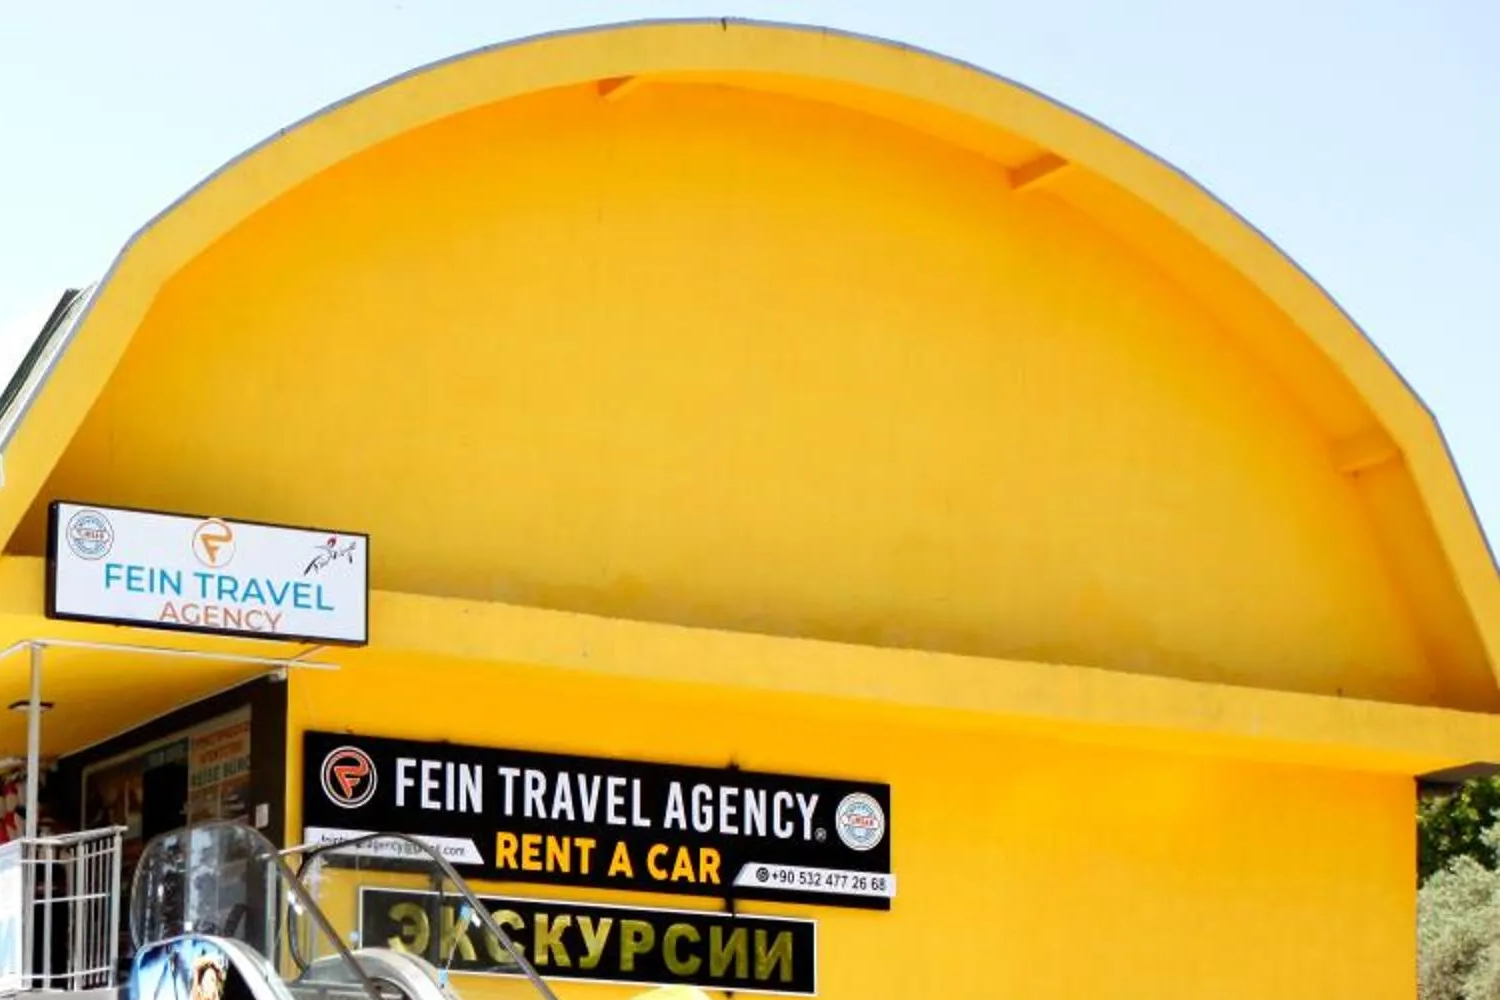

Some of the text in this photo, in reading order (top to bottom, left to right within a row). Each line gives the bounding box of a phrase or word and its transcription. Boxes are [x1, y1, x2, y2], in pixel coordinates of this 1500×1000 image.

[105, 563, 334, 611] FEIN TRAVEL
[159, 601, 283, 633] AGENCY
[395, 757, 819, 840] FEIN TRAVEL AGENCY
[495, 831, 721, 885] RENT A CAR
[772, 870, 795, 884] +90
[800, 871, 821, 886] 532
[825, 873, 848, 888] 477
[852, 875, 867, 890] 26
[387, 901, 795, 983] ЭКСКУРСИИ
